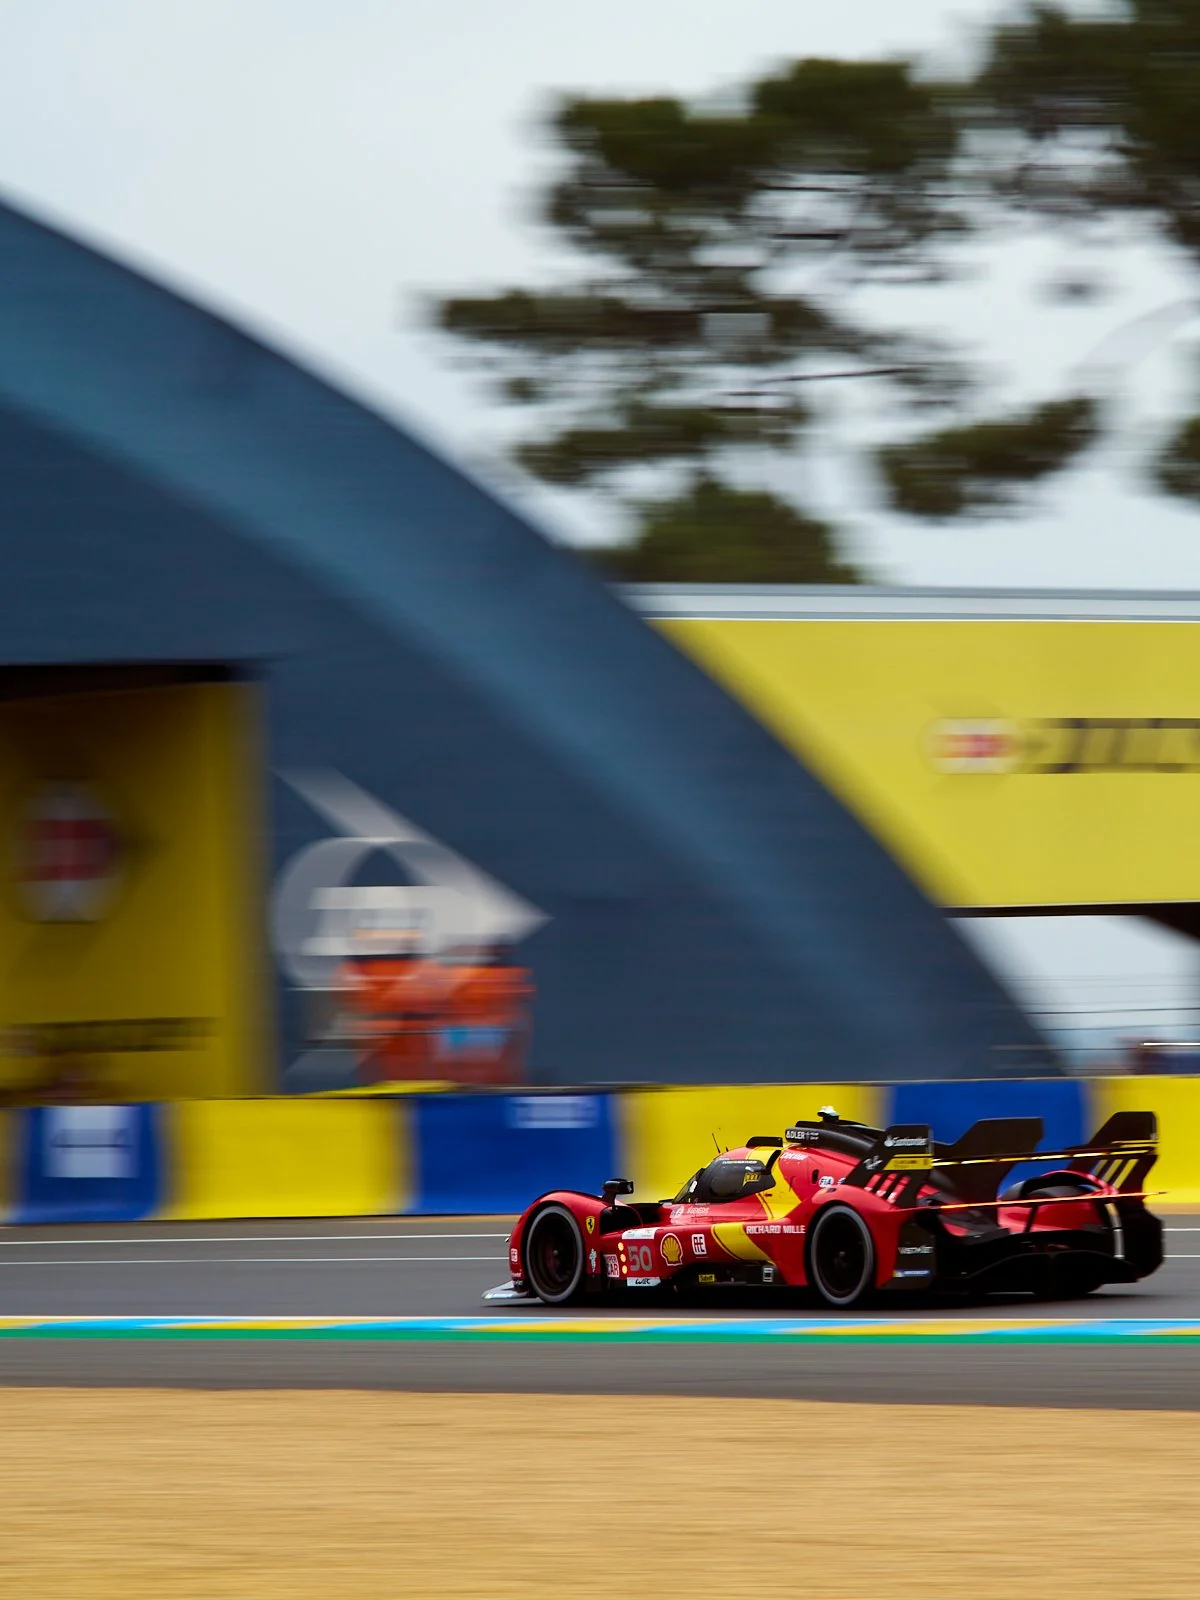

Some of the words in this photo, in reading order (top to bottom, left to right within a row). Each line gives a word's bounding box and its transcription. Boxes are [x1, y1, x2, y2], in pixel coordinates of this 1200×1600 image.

[746, 1225, 781, 1234] RICHARD
[783, 1225, 806, 1234] MILLE
[627, 1245, 653, 1271] 50
